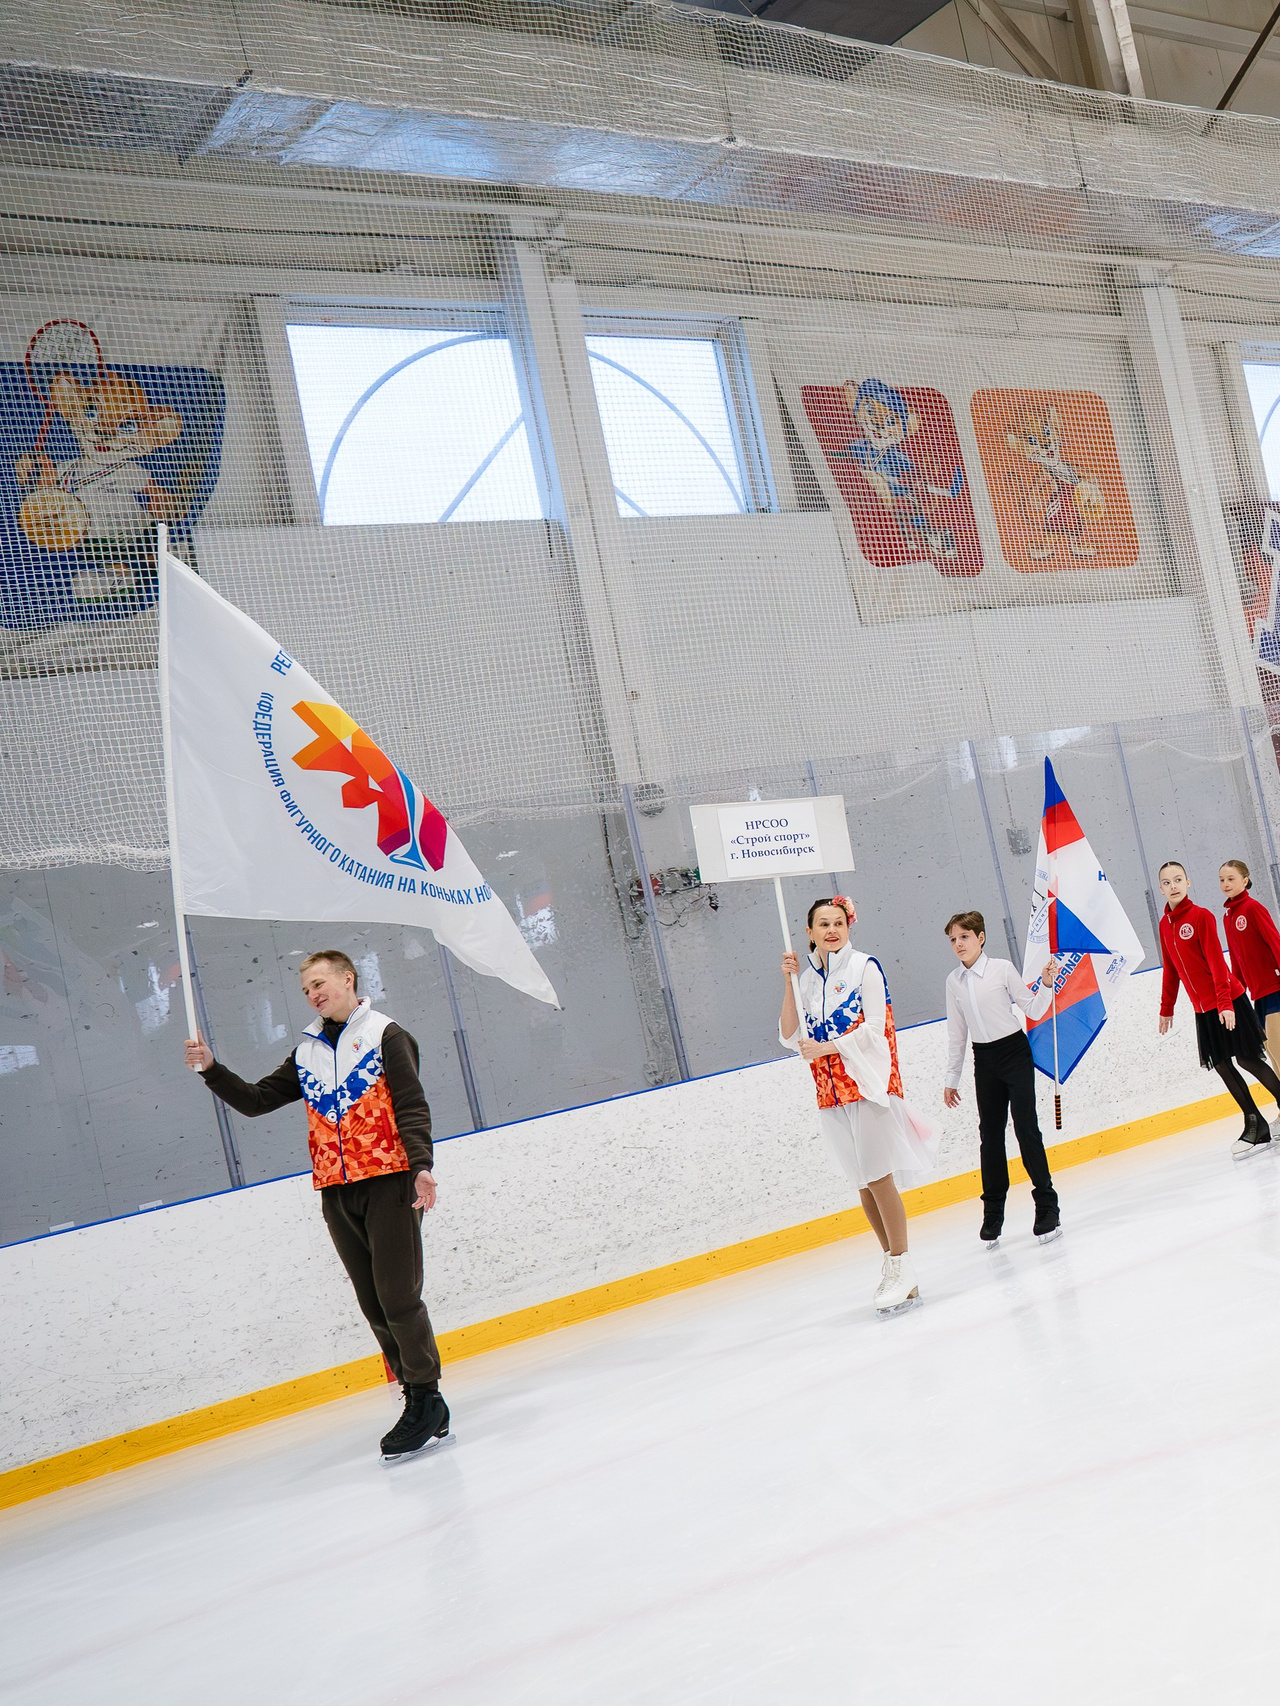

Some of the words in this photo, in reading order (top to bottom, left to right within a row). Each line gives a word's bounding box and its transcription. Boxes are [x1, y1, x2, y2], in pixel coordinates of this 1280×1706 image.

[745, 818, 788, 830] НРСОО
[730, 834, 771, 846] «Строй
[774, 832, 810, 843] спорт»
[278, 788, 340, 863] ФИГУРНОГО
[337, 857, 395, 891] КАТАНИЯ
[397, 875, 417, 894] НА
[420, 880, 473, 906] КОНЬКАХ
[730, 852, 739, 860] г.
[741, 845, 815, 859] Новосибирск
